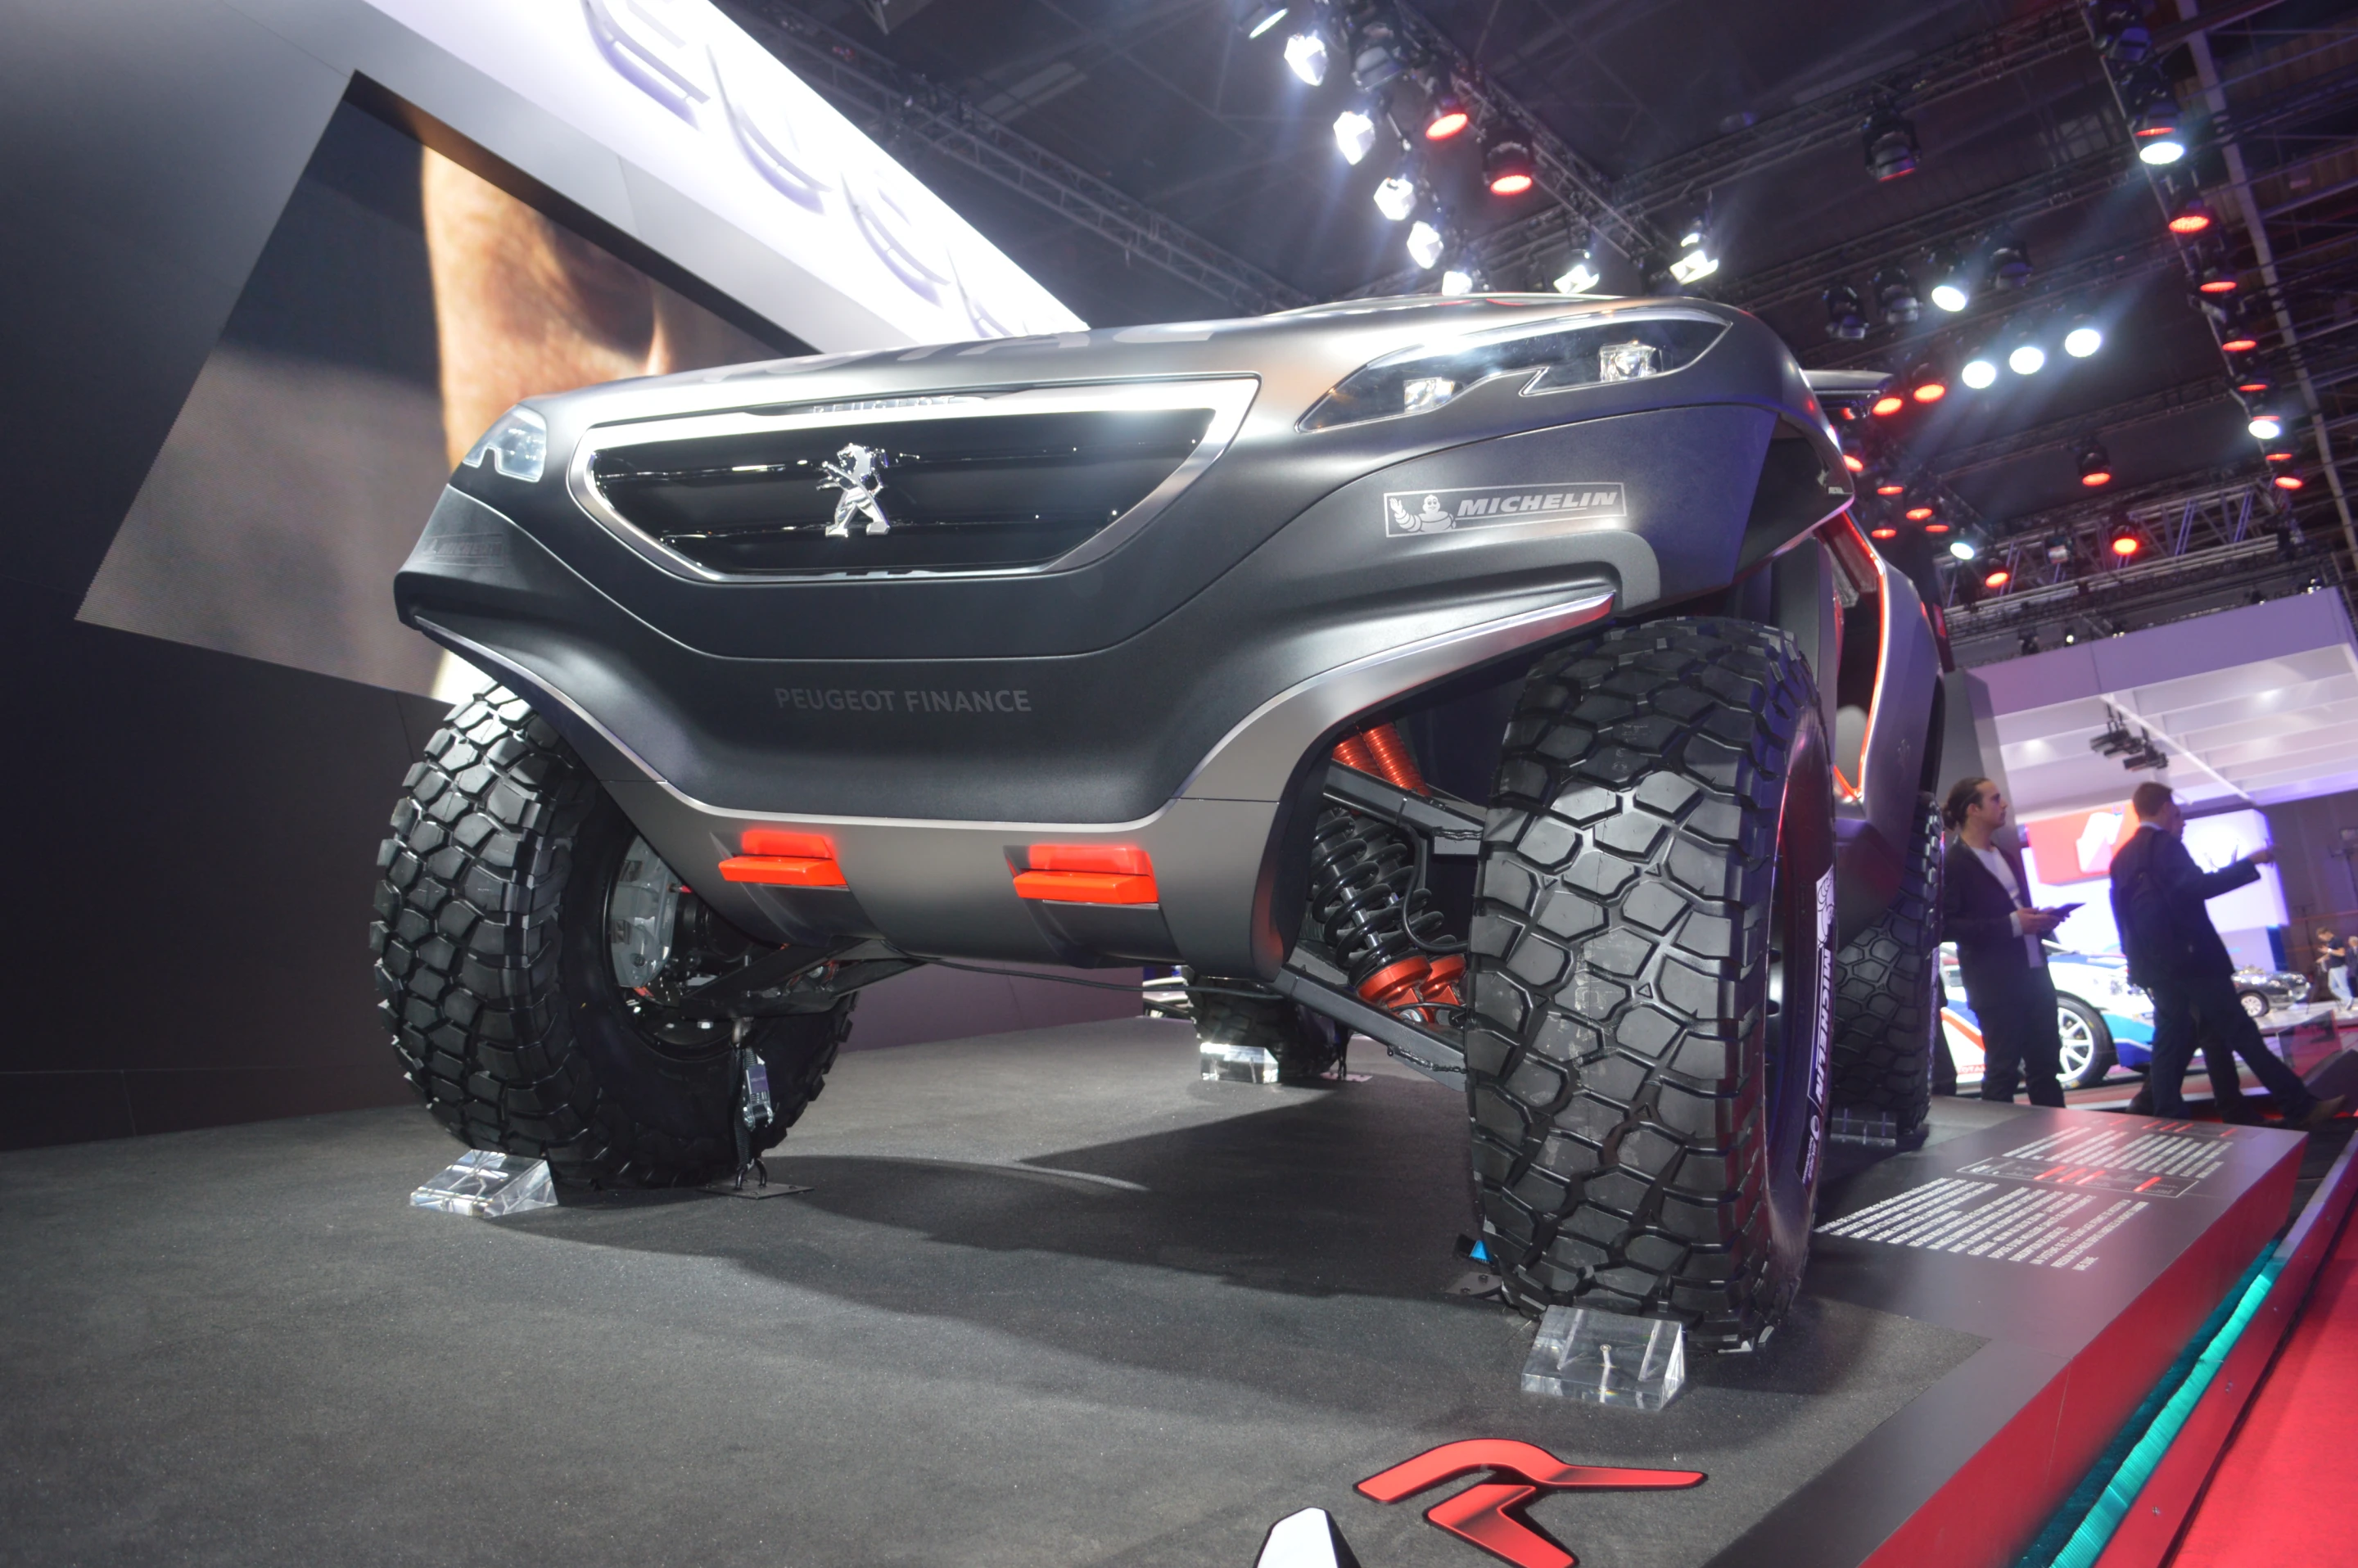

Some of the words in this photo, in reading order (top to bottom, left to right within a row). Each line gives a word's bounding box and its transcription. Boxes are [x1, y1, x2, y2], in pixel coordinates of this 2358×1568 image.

[1457, 492, 1617, 515] MICHELIN
[775, 688, 895, 711] PEUGEOT
[904, 690, 1032, 712] FINANCE
[1815, 949, 1832, 1105] MICHELIN
